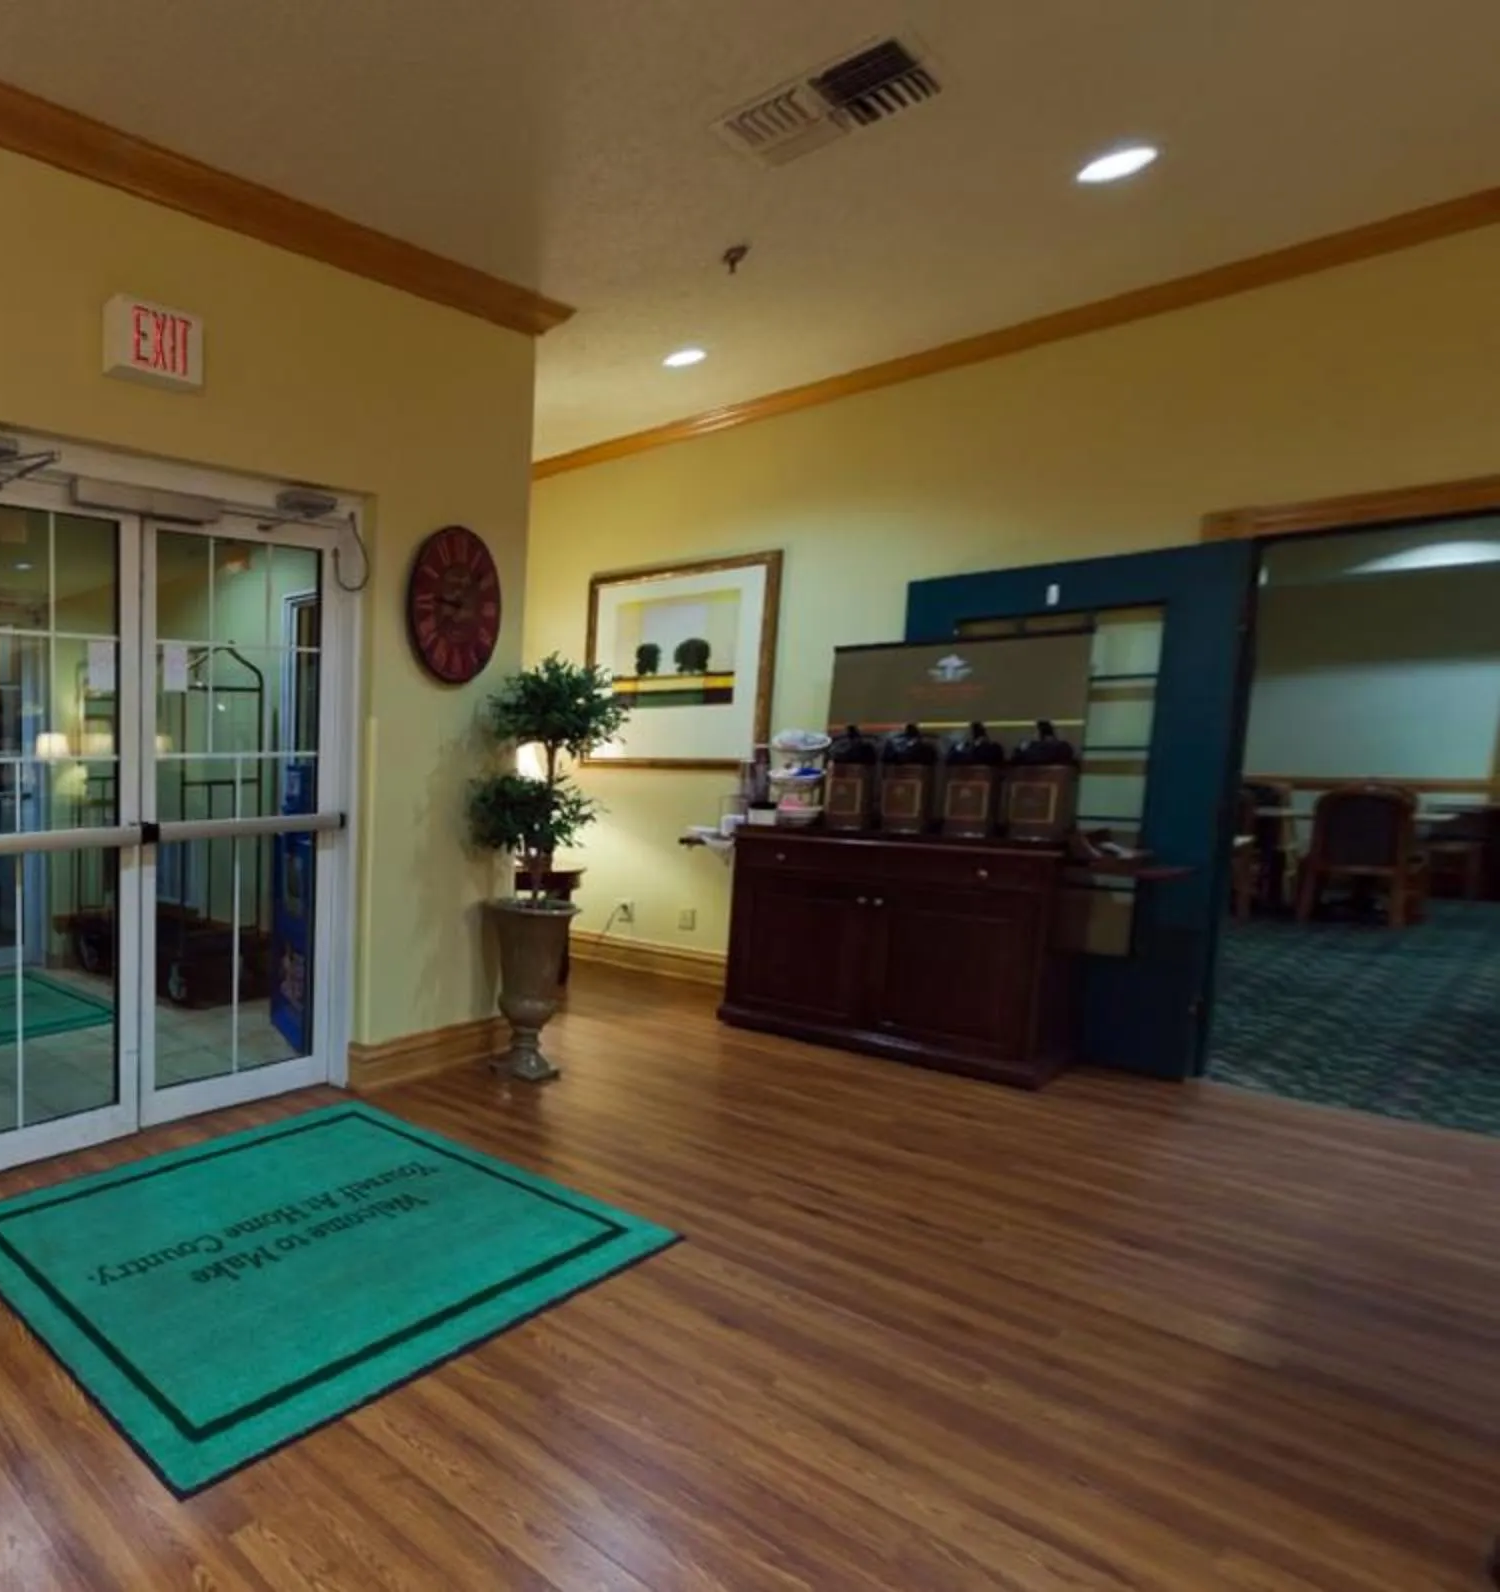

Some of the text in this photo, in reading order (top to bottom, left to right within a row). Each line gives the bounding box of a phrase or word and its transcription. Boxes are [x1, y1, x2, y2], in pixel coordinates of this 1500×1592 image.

[131, 304, 193, 378] EXIT
[302, 1191, 341, 1212] At
[336, 1161, 440, 1203] Yourself
[190, 1192, 430, 1283] Welcome to Make
[222, 1204, 312, 1238] Home
